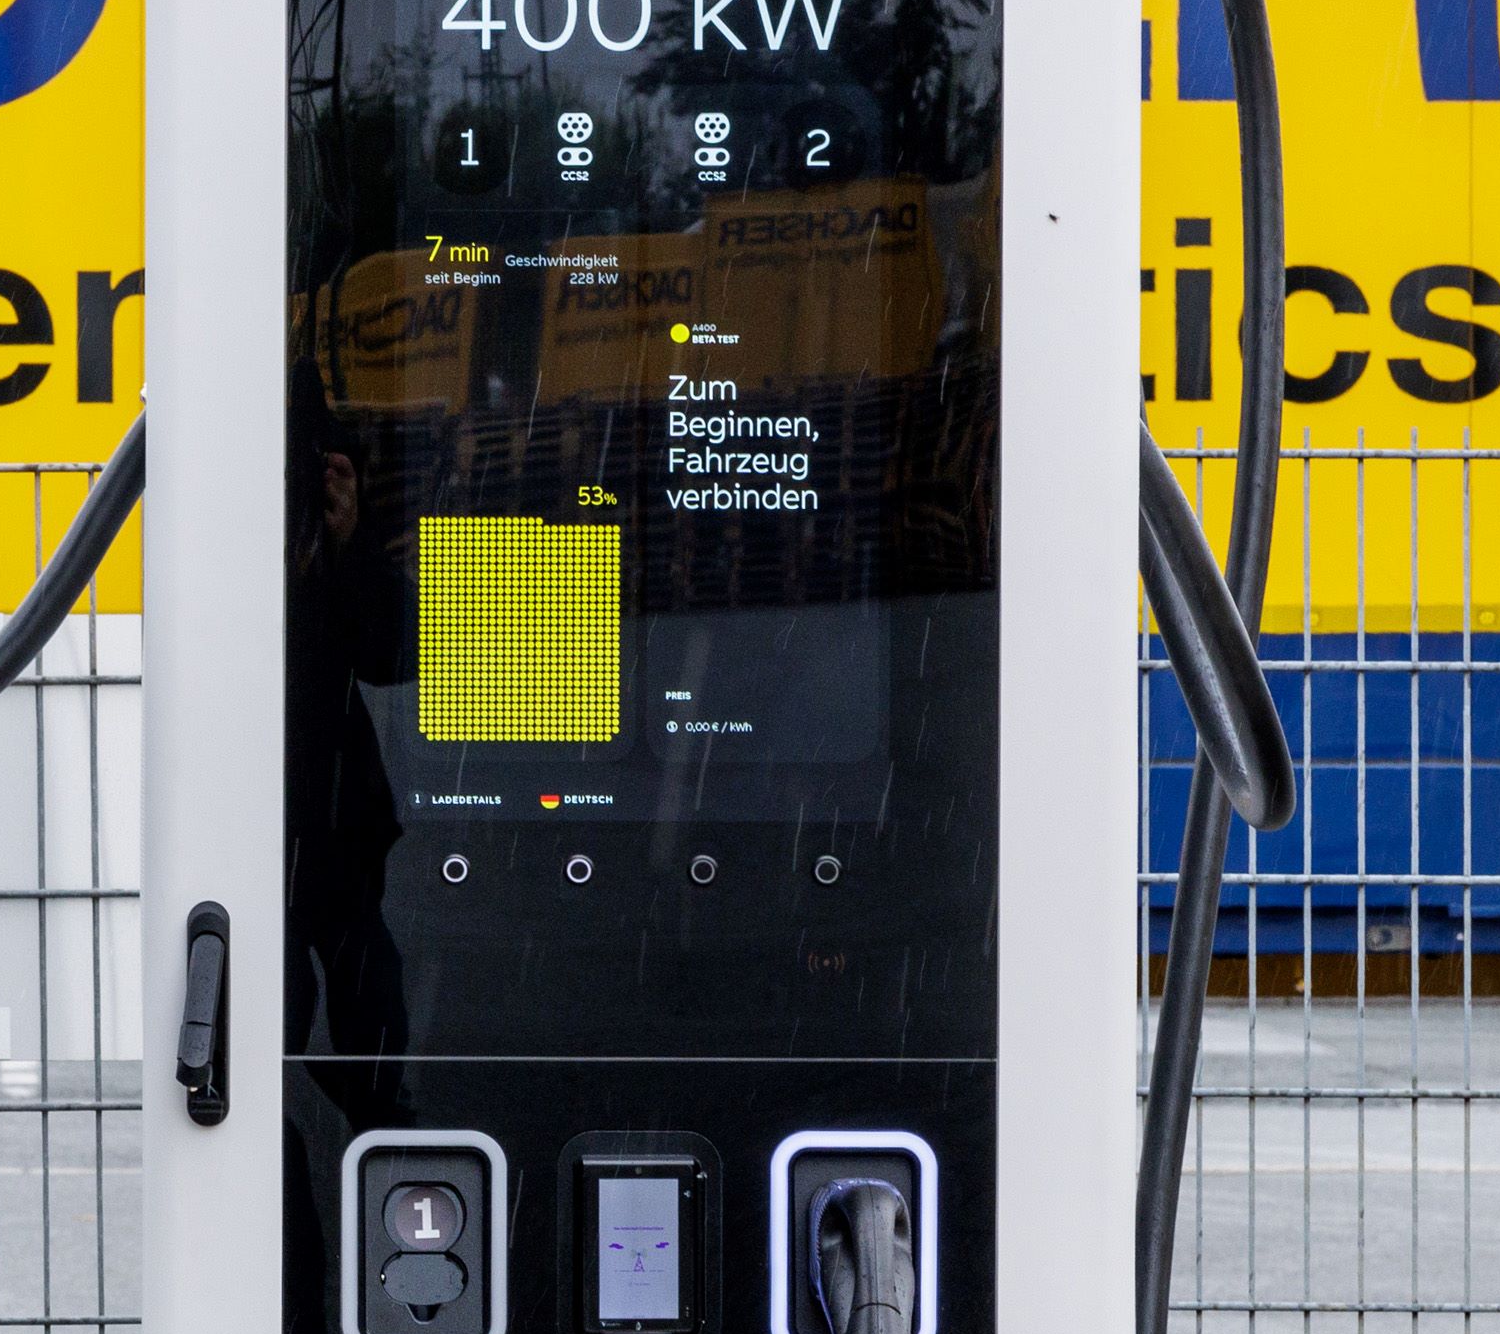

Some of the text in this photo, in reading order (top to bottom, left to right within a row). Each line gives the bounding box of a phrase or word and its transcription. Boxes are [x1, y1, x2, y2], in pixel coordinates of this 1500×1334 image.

[460, 128, 480, 167] 1
[806, 128, 831, 167] 2
[561, 170, 589, 182] CCS2
[698, 170, 726, 182] CCS2
[425, 235, 489, 263] 7 min
[505, 254, 619, 270] Geschwindigkeit
[425, 271, 501, 287] seit Beginn
[569, 272, 619, 285] 228 kW
[692, 323, 717, 332] A400
[692, 334, 740, 344] BETA TEST
[668, 374, 737, 402] Zum
[668, 411, 820, 444] Beginnen,
[668, 447, 809, 481] Fahrzeug
[577, 485, 618, 508] 53%
[667, 483, 819, 511] verbinden
[665, 691, 692, 700] PREIS
[685, 722, 710, 733] 0,00
[729, 721, 752, 732] kWh
[432, 795, 502, 805] LADEDETAILS
[564, 795, 614, 805] DEUTSCH
[414, 1197, 441, 1239] 1
